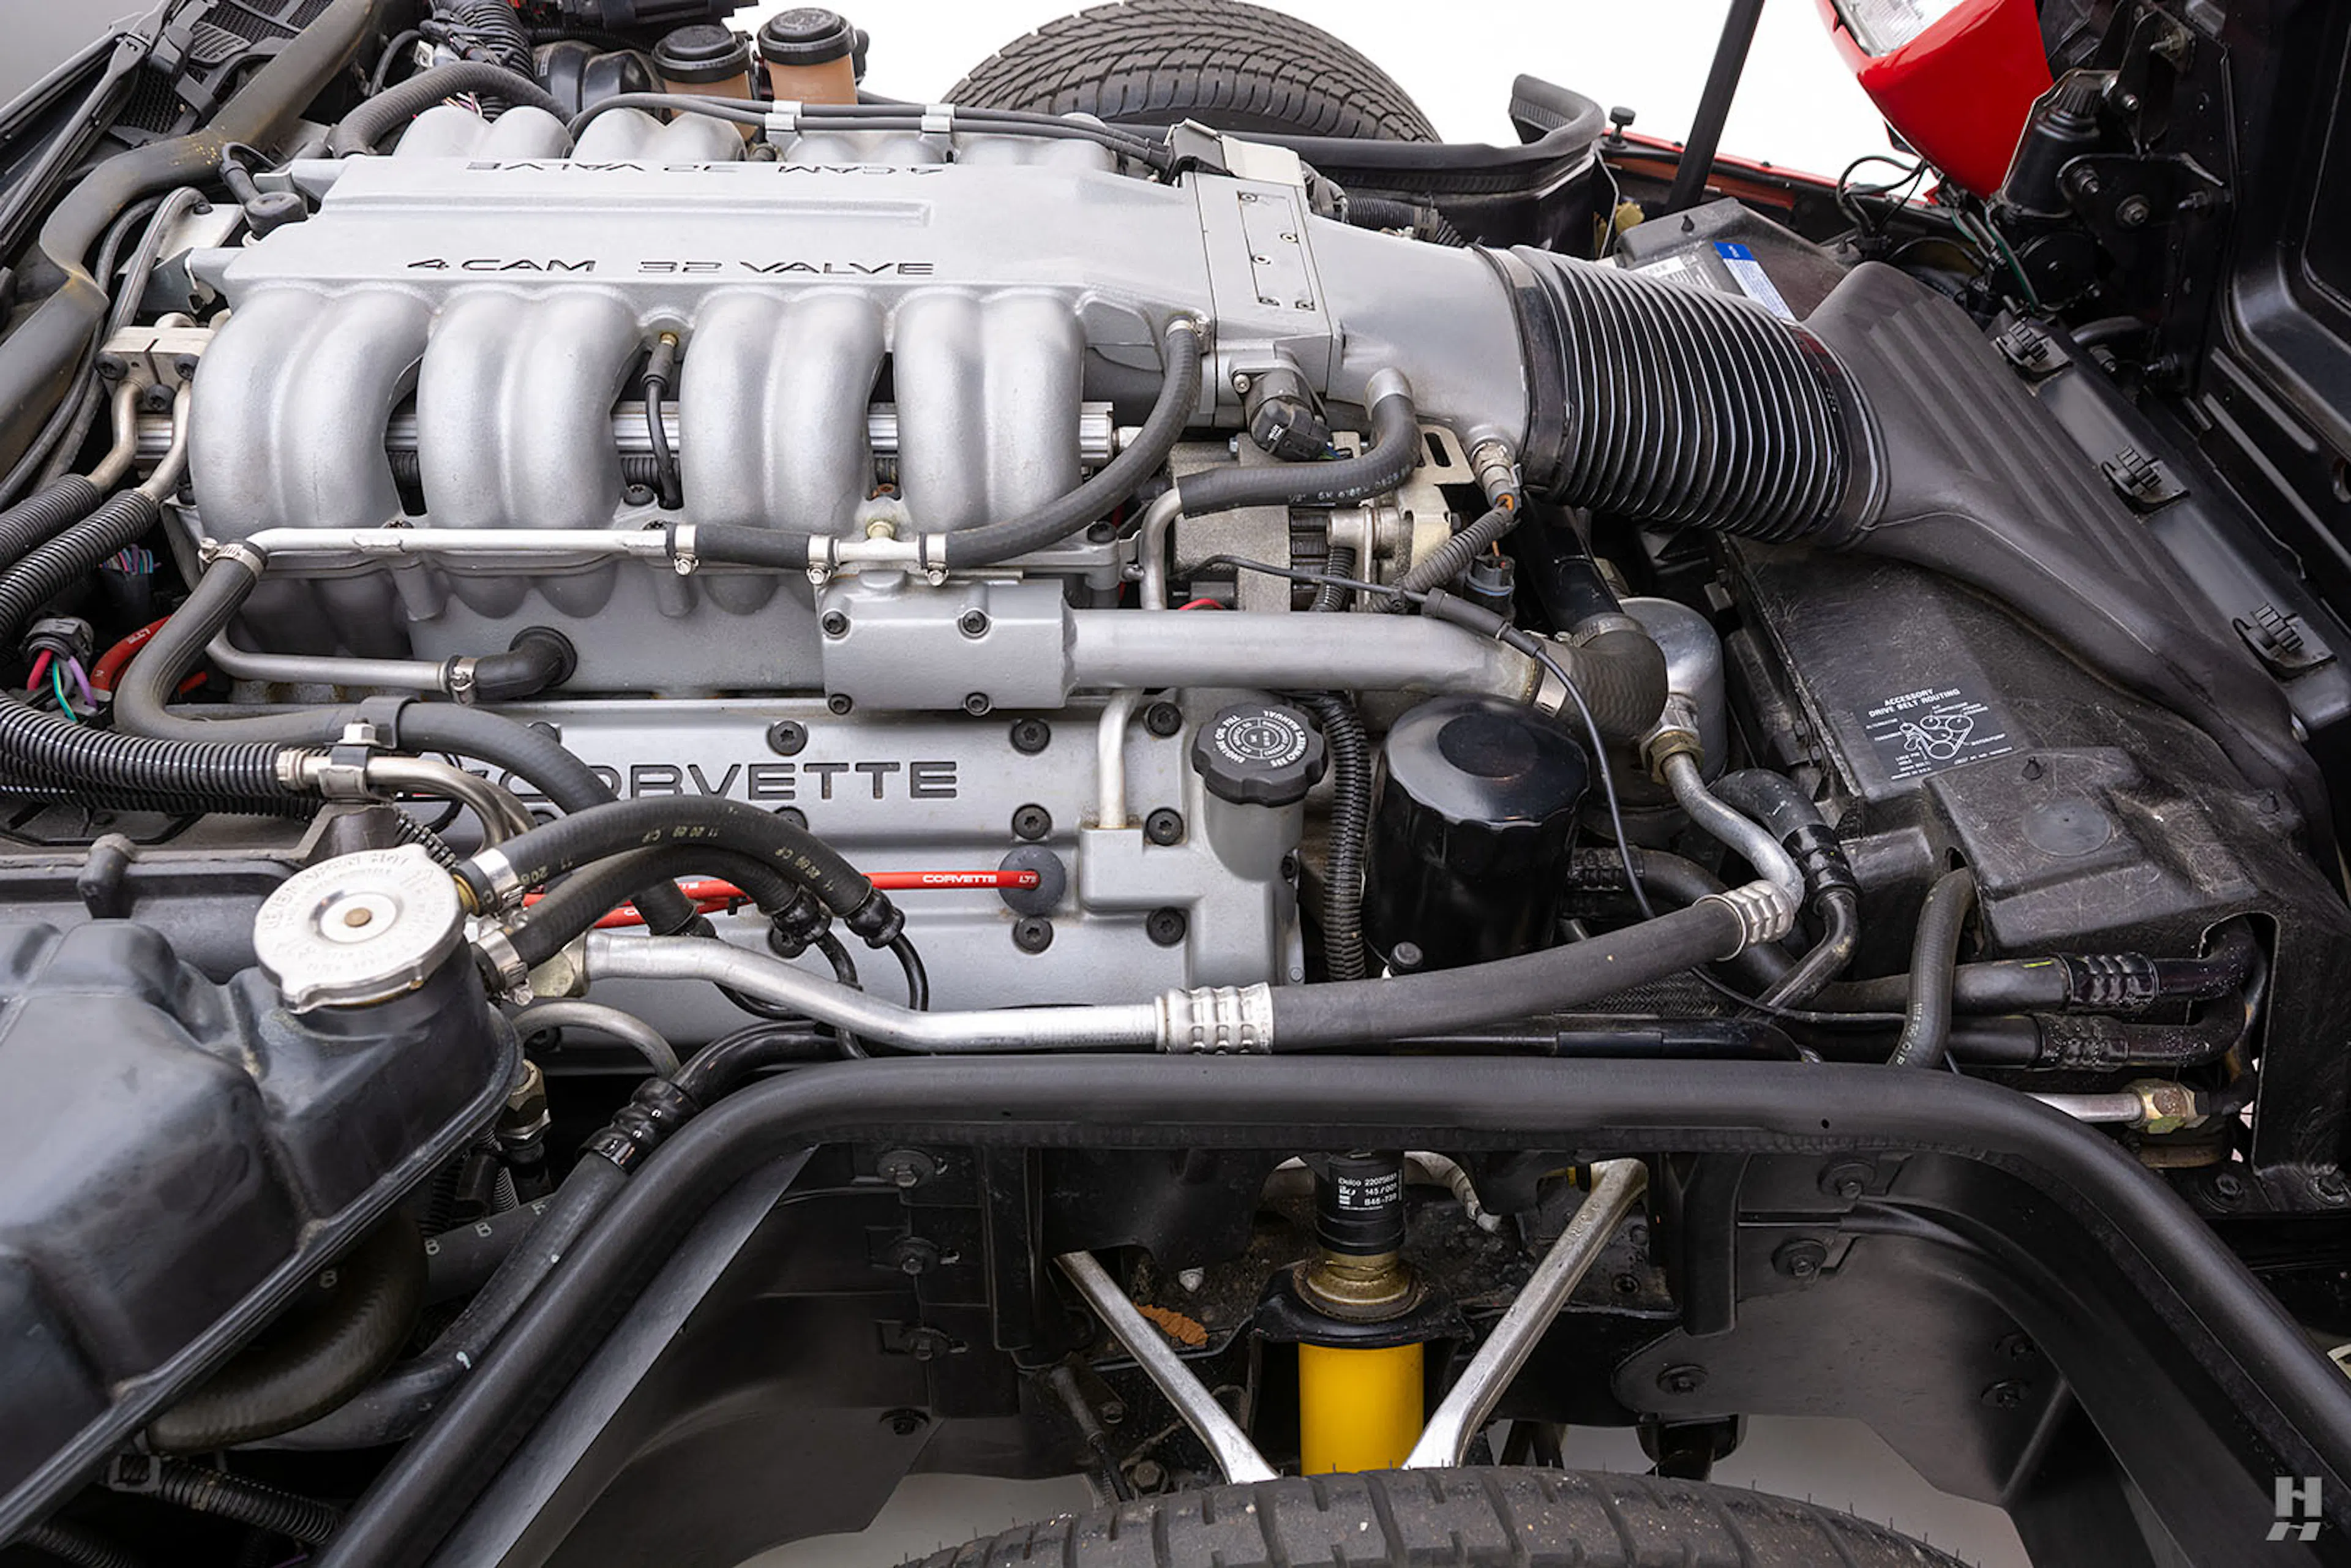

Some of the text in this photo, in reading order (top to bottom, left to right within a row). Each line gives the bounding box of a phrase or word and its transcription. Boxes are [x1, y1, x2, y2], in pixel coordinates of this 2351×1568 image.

[637, 260, 723, 274] 32
[739, 261, 934, 275] VALVE
[1868, 706, 1896, 718] DRIVE
[1895, 699, 1919, 711] BELT
[1921, 688, 1961, 704] ROUTING
[1884, 688, 1933, 707] ACCESSORY
[1222, 714, 1242, 727] FILL
[1262, 710, 1302, 732] MANUAL
[1215, 727, 1226, 740] OIL
[1215, 740, 1247, 764] ENGINE
[922, 874, 997, 883] CORVETTE
